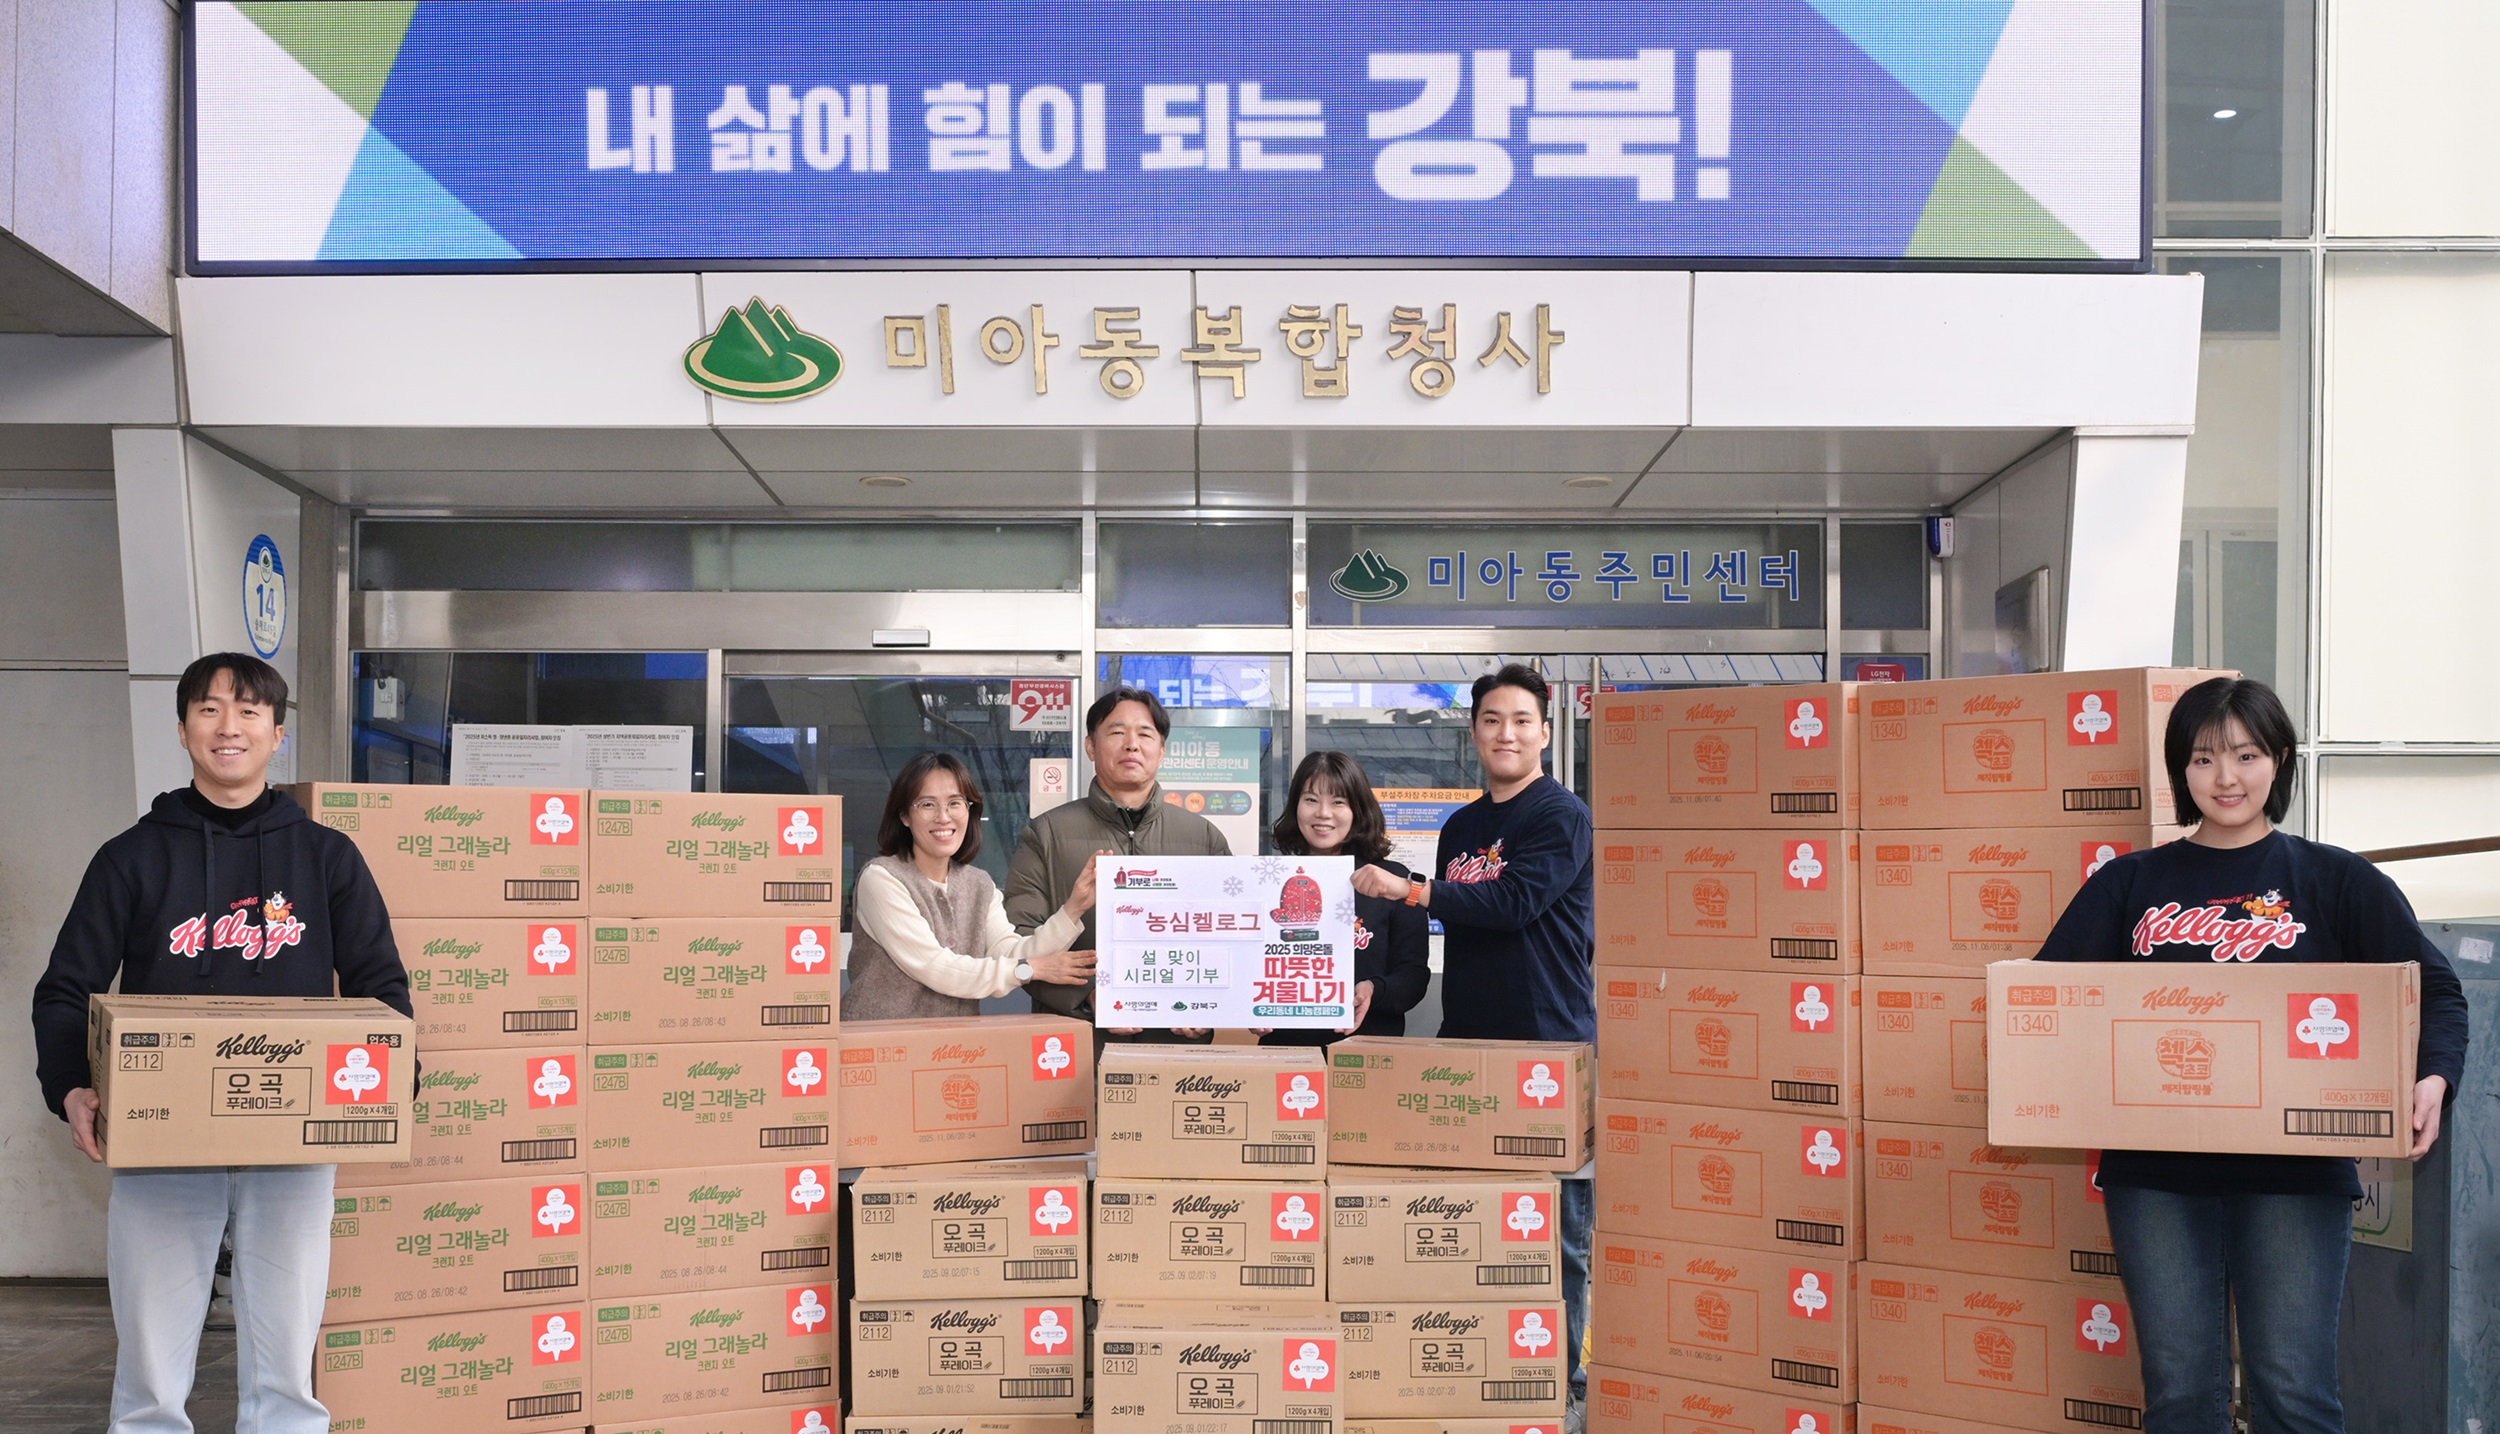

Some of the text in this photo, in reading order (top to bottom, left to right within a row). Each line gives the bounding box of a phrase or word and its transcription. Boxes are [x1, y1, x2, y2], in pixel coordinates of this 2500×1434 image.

[587, 48, 1733, 201] 내 삶에 힘이 되는 강북!
[883, 303, 1566, 400] 미아동복합청사
[1427, 549, 1799, 603] 미아동주민센터
[256, 584, 275, 621] 14
[1018, 690, 1064, 725] 911
[1686, 703, 1738, 724] Kellogg's
[1963, 694, 2023, 717] Kellogg's
[1608, 728, 1633, 742] 1340
[1874, 722, 1903, 738] 1340
[1170, 741, 1220, 758] 미아동
[1206, 757, 1249, 770] 운영안내
[1381, 791, 1420, 799] 부설주차장
[1422, 791, 1452, 799] 주차요금
[425, 804, 485, 827] Kellogg's
[691, 811, 747, 831] Kellogg's
[600, 820, 630, 834] 1247B
[397, 836, 511, 857] 리얼 그래놀라
[666, 840, 769, 861] 리얼 그래놀라
[1968, 843, 2030, 867] Kellogg's
[433, 860, 475, 871] 크런치 오트
[1685, 847, 1737, 868] Kellogg's
[699, 863, 737, 874] 크런치 오트
[1880, 868, 1908, 883] 1340
[596, 883, 634, 894] 소비기한
[1146, 912, 1261, 933] 농심켈로그
[2132, 902, 2306, 962] Kellogg's
[423, 938, 483, 959] Kellogg's
[596, 948, 627, 962] 1247B
[688, 936, 743, 956] Kellogg's
[1265, 944, 1333, 955] 2025 희망온돌
[1142, 950, 1201, 966] 설 맞이
[437, 968, 509, 989] 그래놀라
[663, 965, 767, 986] 리얼 그래놀라
[1125, 969, 1219, 984] 시리얼 기부
[1264, 957, 1334, 980] 따뜻한
[1254, 982, 1345, 1004] 겨울나기
[2012, 989, 2053, 1003] 취급주의
[2141, 986, 2230, 1015] Kellogg's
[1191, 1002, 1218, 1010] 강북구
[1258, 1007, 1293, 1016] 우리동네
[2012, 1013, 2053, 1033] 1340
[124, 1035, 158, 1046] 취급주의
[216, 1033, 305, 1063] Kellogg's
[123, 1053, 159, 1069] 2112
[932, 1044, 987, 1064] Kellogg's
[421, 1070, 482, 1091] Kellogg's
[688, 1061, 743, 1080] Kellogg's
[843, 1069, 873, 1084] 1340
[1335, 1073, 1363, 1086] 1247B
[1421, 1066, 1476, 1086] Kellogg's
[596, 1075, 626, 1089] 1247B
[1175, 1075, 1242, 1099] Kellogg's
[226, 1097, 282, 1110] 푸레이크
[663, 1089, 766, 1111] 리얼 그래놀라
[1107, 1090, 1133, 1101] 2112
[1397, 1093, 1499, 1115] 리얼 그래놀라
[127, 1108, 170, 1120] 소비기한
[435, 1099, 508, 1121] 그래놀라
[2014, 1105, 2060, 1118] 소비기한
[1111, 1132, 1142, 1142] 소비기한
[1183, 1125, 1226, 1135] 푸레이크
[1689, 1123, 1743, 1145] Kellogg's
[688, 1185, 744, 1205] Kellogg's
[933, 1191, 1002, 1215] Kellogg's
[423, 1201, 484, 1223] Kellogg's
[864, 1210, 891, 1222] 2112
[1104, 1210, 1130, 1222] 2112
[1172, 1194, 1241, 1219] Kellogg's
[1407, 1195, 1475, 1220] Kellogg's
[664, 1211, 767, 1236] 리얼 그래놀라
[1338, 1213, 1364, 1225] 2112
[397, 1228, 510, 1256] 리얼 그래놀라
[944, 1242, 986, 1252] 푸레이크
[1181, 1246, 1224, 1256] 푸레이크
[1416, 1247, 1459, 1257] 푸레이크
[870, 1251, 902, 1262] 소비기한
[1107, 1253, 1139, 1263] 소비기한
[1343, 1256, 1374, 1266] 소비기한
[1686, 1258, 1739, 1282] Kellogg's
[1964, 1291, 2024, 1316] Kellogg's
[690, 1308, 745, 1328] Kellogg's
[930, 1310, 998, 1333] Kellogg's
[1412, 1311, 1479, 1335] Kellogg's
[427, 1332, 488, 1353] Kellogg's
[862, 1327, 888, 1339] 2112
[1344, 1328, 1370, 1340] 2112
[665, 1333, 768, 1360] 리얼 그래놀라
[1179, 1343, 1252, 1370] Kellogg's
[327, 1353, 361, 1370] 1247B
[1106, 1360, 1134, 1372] 2112
[1422, 1362, 1465, 1372] 푸레이크
[401, 1357, 513, 1387] 리얼 그래놀라
[1349, 1370, 1380, 1380] 소비기한
